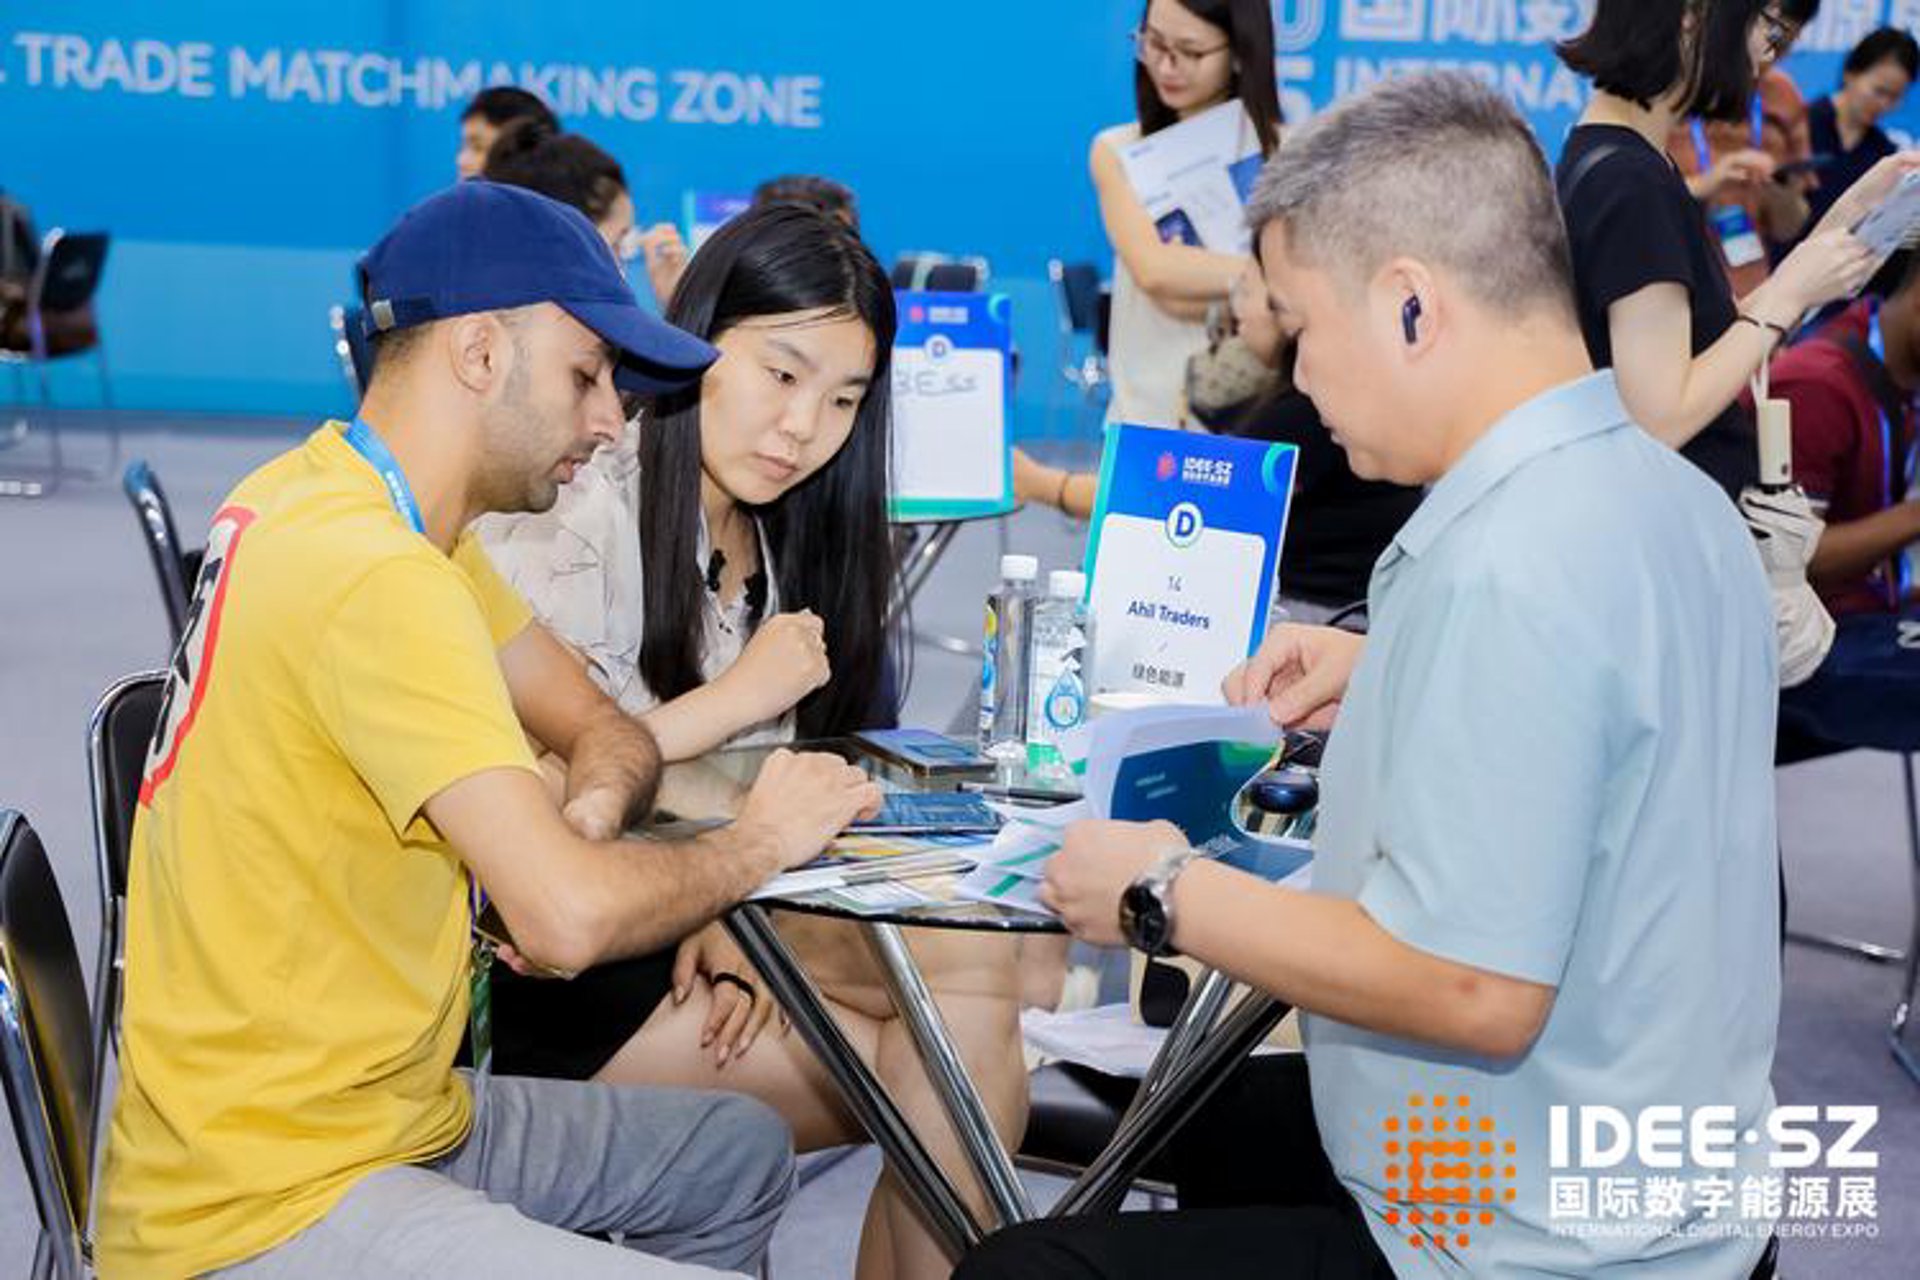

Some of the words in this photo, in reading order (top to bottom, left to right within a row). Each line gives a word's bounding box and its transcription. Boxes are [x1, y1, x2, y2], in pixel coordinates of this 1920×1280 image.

[14, 32, 215, 97] TRADE
[668, 70, 822, 128] ZONE
[1174, 512, 1195, 536] D
[1127, 599, 1156, 618] Ahil
[1159, 604, 1210, 630] Traders
